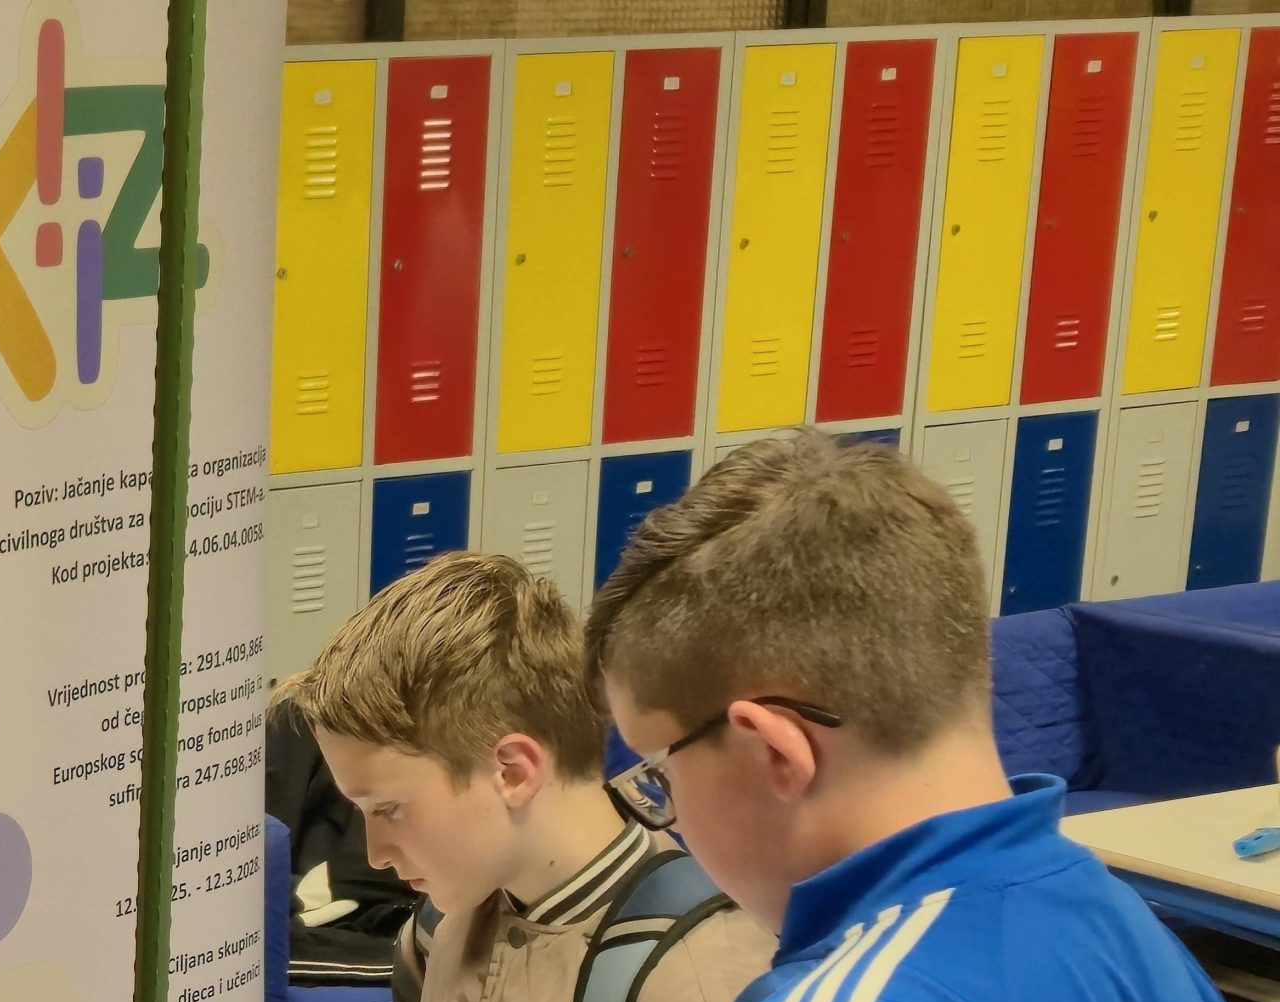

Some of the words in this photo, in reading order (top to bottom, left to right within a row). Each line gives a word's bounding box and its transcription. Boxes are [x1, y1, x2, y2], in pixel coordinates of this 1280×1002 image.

[14, 485, 58, 509] Poziv:
[62, 474, 115, 503] Jačanje
[203, 445, 266, 477] organizacija
[70, 514, 123, 540] društva
[128, 512, 144, 528] za
[51, 561, 78, 585] Kod
[82, 550, 149, 583] projekta:
[47, 674, 120, 707] Vrijednost
[197, 635, 264, 672] 291.409,86€
[101, 710, 119, 732] od
[230, 678, 255, 702] unija
[53, 749, 126, 785] Europskog
[207, 723, 243, 746] fonda
[246, 712, 263, 738] plus
[194, 746, 262, 785] 247.698,38€
[168, 950, 214, 975] Ciljana
[218, 929, 261, 959] skupina:
[227, 960, 261, 991] učenici
